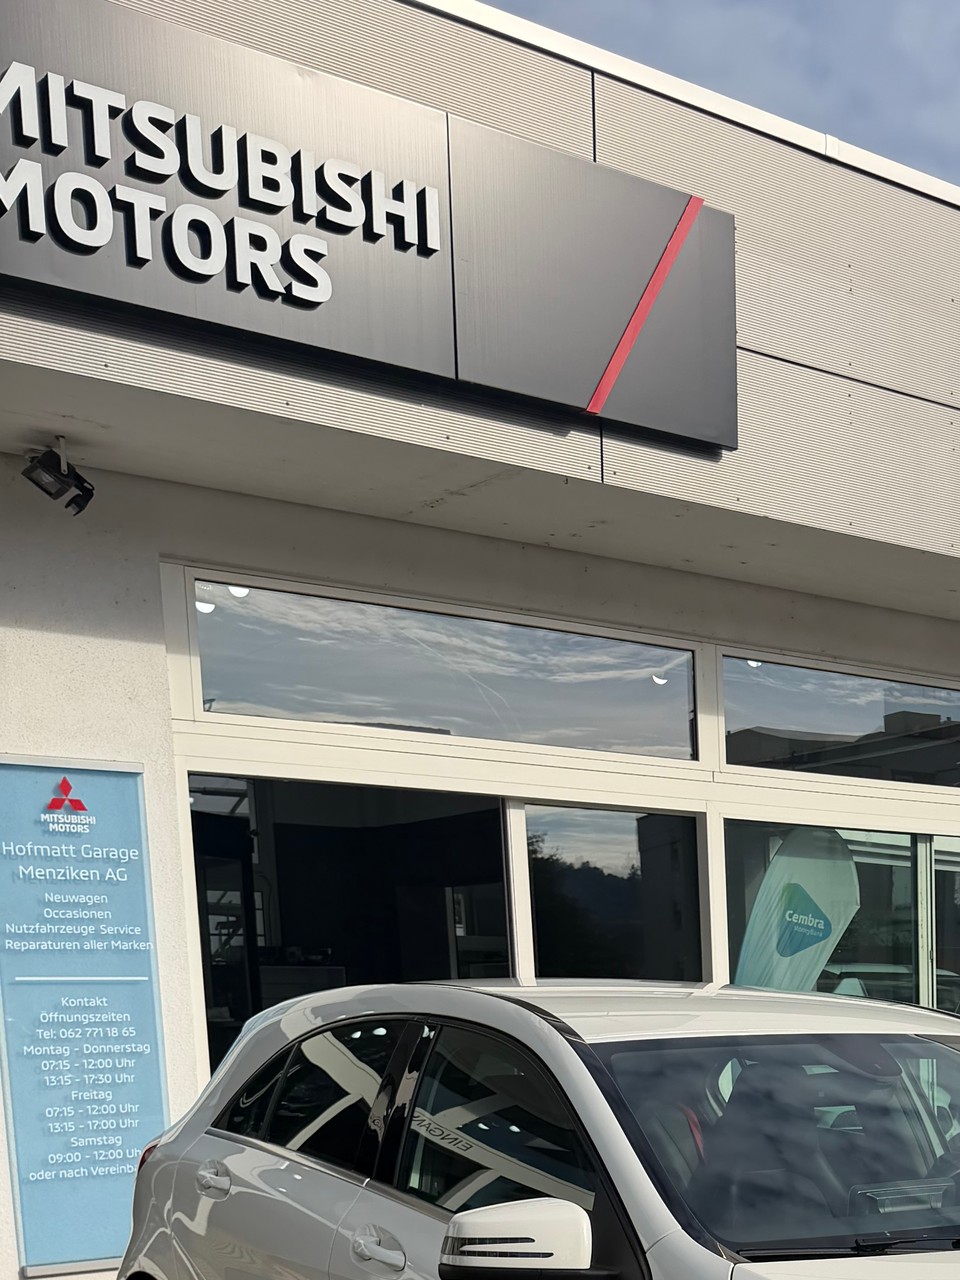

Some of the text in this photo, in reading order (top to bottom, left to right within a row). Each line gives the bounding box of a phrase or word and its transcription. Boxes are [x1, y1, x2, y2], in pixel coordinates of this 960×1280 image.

[0, 61, 441, 255] MITSUBISHI
[0, 157, 333, 304] MOTORS
[40, 813, 96, 825] MITSUBISHI
[49, 823, 90, 833] MOTORS
[2, 841, 139, 862] Hofmatt Garage
[19, 865, 128, 881] Menziken AG
[44, 892, 108, 905] Neuwagen
[43, 908, 112, 919] Occasionen
[785, 910, 825, 929] Cembra
[5, 923, 142, 936] Nutzfahrzeuge Service
[5, 939, 153, 952] Reparaturen aller Marken
[61, 997, 108, 1007] Kontakt
[40, 1012, 131, 1024] Öffnungszeiten
[36, 1027, 136, 1039] Tel: 062 771 18 65
[23, 1045, 70, 1057] Montag
[83, 1043, 151, 1055] Donnerstag
[41, 1060, 70, 1071] 07:15
[83, 1058, 113, 1069] 12:00
[115, 1058, 136, 1068] Uhr
[44, 1075, 72, 1086] 13:15
[84, 1073, 112, 1085] 17:30
[115, 1073, 135, 1083] Uhr
[71, 1090, 113, 1101] Freitag
[45, 1107, 75, 1118] 07:15
[86, 1104, 116, 1115] 12:00
[119, 1103, 139, 1113] Uhr
[48, 1122, 75, 1133] 13:15
[87, 1120, 116, 1131] 17:00
[119, 1118, 139, 1129] Uhr
[70, 1135, 122, 1147] Samstag
[48, 1153, 81, 1164] 09:00
[94, 1150, 123, 1161] 12:00
[126, 1148, 142, 1158] Uh
[29, 1163, 137, 1181] oder nach Vereinb
